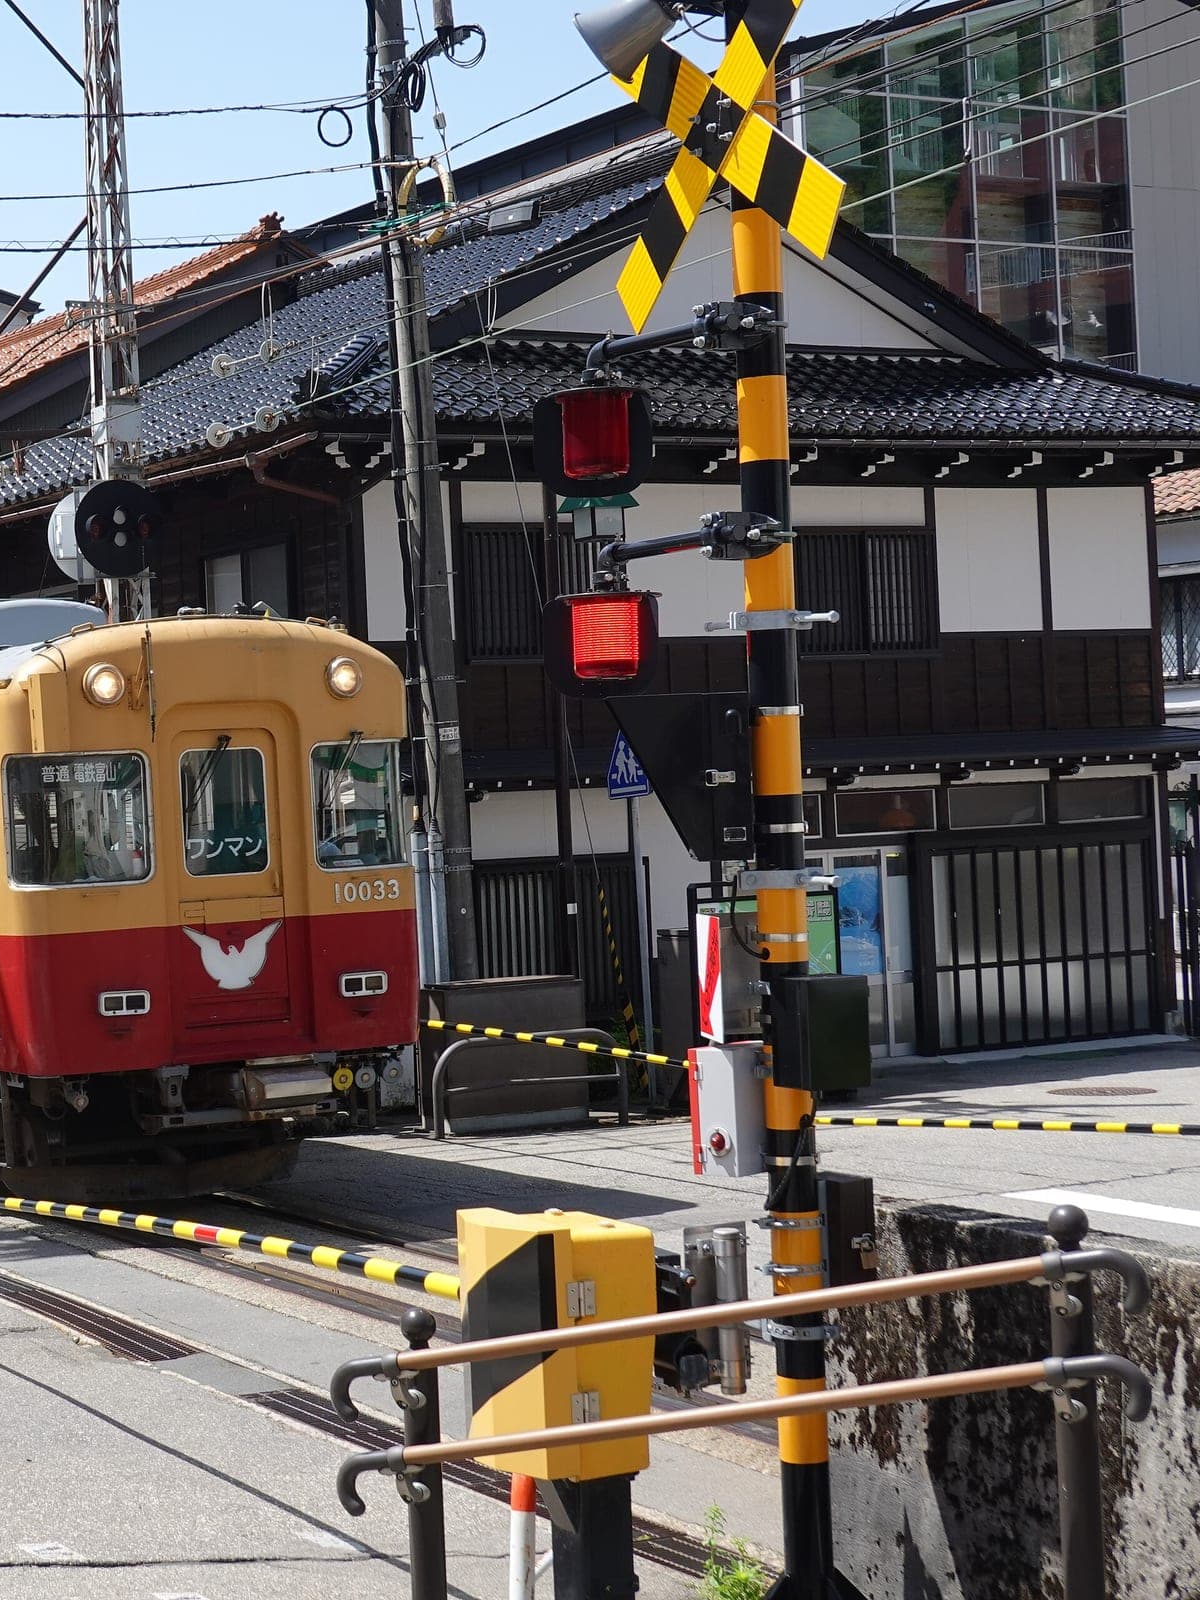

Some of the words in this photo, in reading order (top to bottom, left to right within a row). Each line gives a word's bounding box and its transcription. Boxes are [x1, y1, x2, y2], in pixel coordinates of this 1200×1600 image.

[41, 765, 70, 783] 普通
[74, 762, 117, 783] 電鉄富山
[187, 836, 262, 860] ワンマン
[334, 879, 400, 904] 10033
